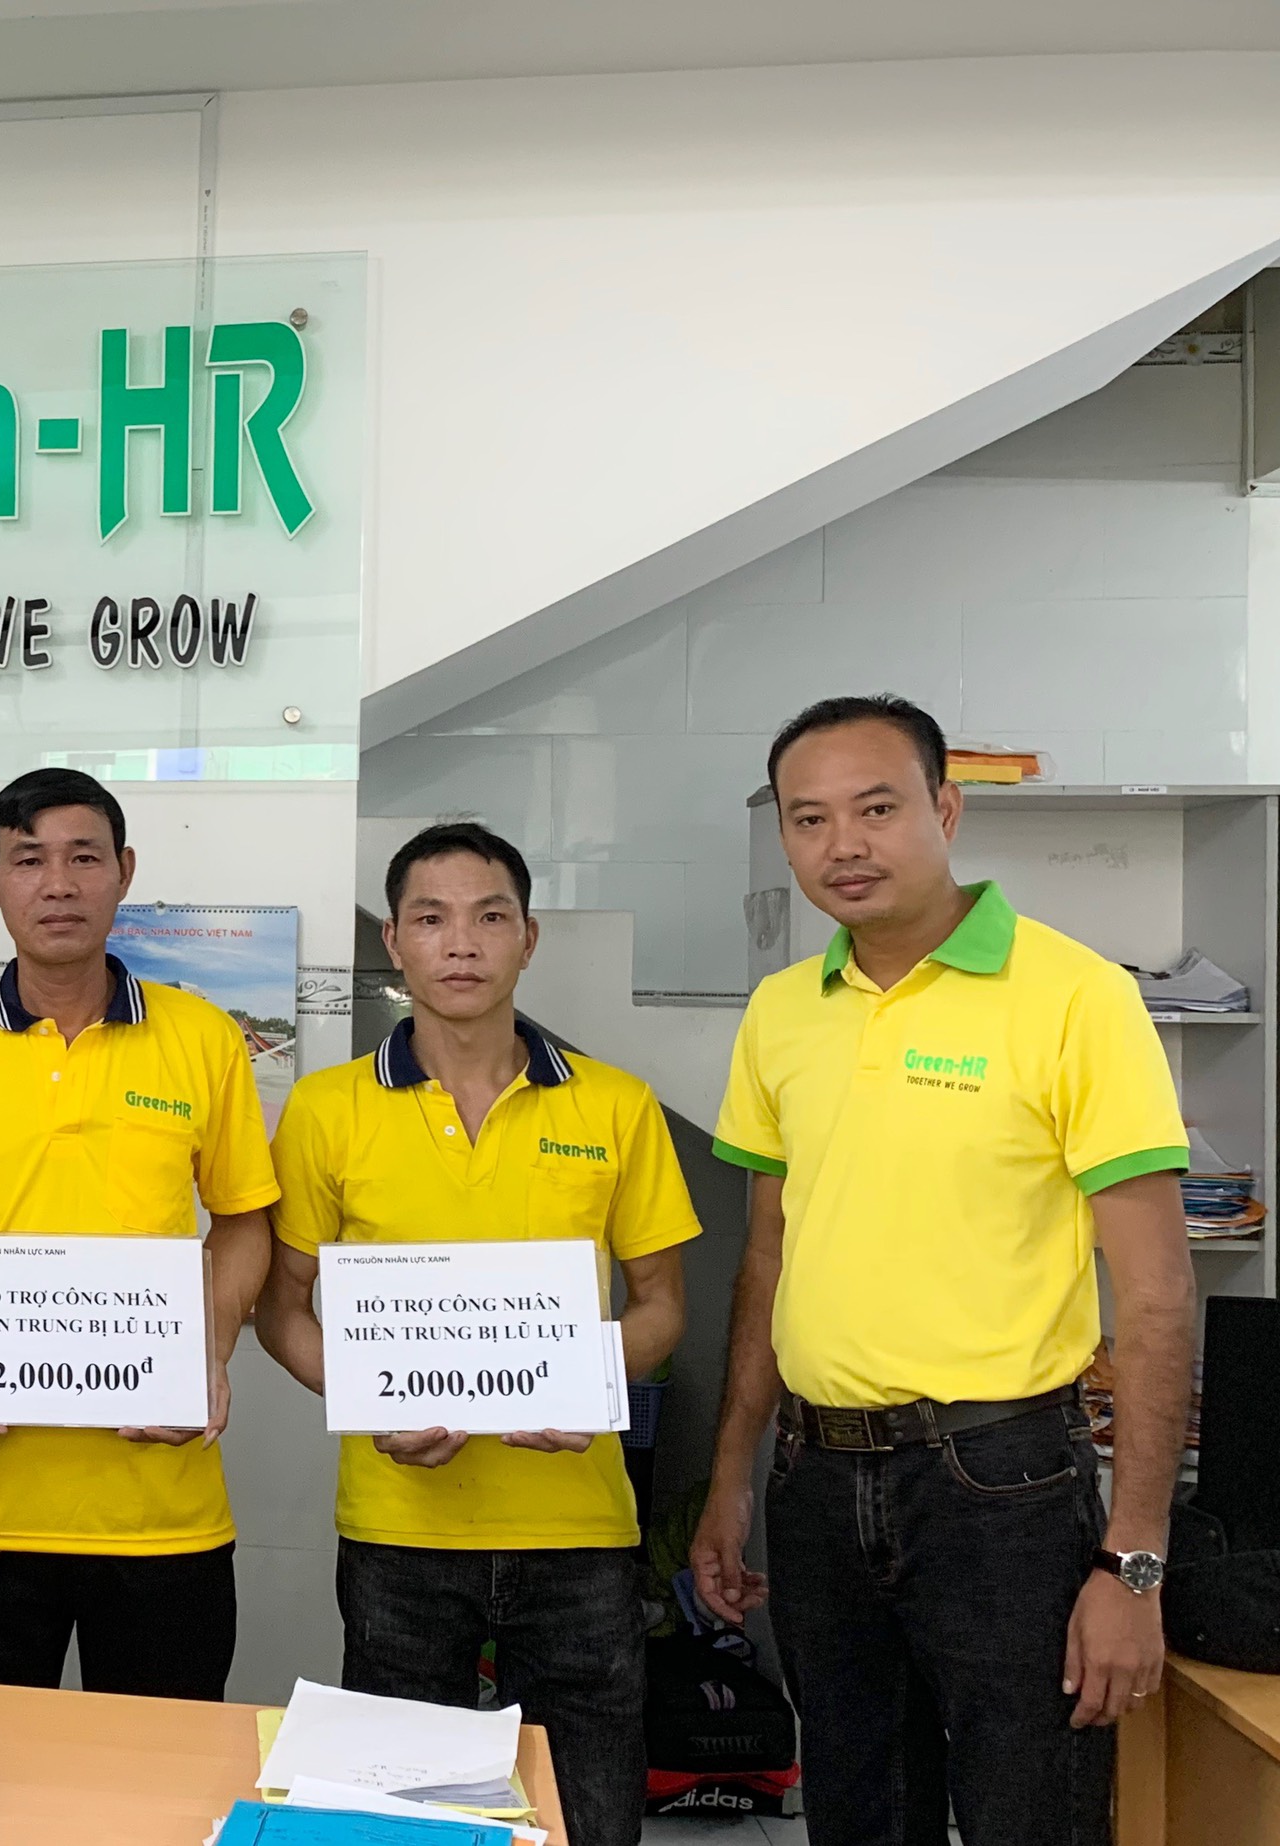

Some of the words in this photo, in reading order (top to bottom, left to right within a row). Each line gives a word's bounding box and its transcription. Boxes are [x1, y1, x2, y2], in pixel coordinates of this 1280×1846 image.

[89, 592, 258, 669] GROW
[231, 929, 253, 937] NAM
[905, 1049, 988, 1080] Green-HR
[907, 1075, 941, 1087] TOGETHER
[945, 1081, 955, 1090] WE
[959, 1083, 981, 1093] GROW
[125, 1091, 192, 1120] Green-HR
[539, 1137, 608, 1162] Green-HR
[3, 1247, 26, 1255] NHÂN
[28, 1248, 43, 1256] LỰC
[385, 1255, 408, 1264] NHÂN
[411, 1256, 426, 1264] LỰC
[7, 1290, 47, 1308] TRỢ
[52, 1287, 107, 1305] CÔNG
[113, 1289, 167, 1306] NHÂN
[391, 1297, 433, 1316] TRỢ
[438, 1294, 496, 1312] CÔNG
[503, 1292, 560, 1311] NHÂN
[16, 1318, 83, 1333] TRUNG
[89, 1319, 107, 1336] BỊ
[113, 1317, 138, 1334] LŨ
[145, 1320, 183, 1338] LỤT
[401, 1325, 471, 1341] TRUNG
[478, 1326, 497, 1343] BỊ
[505, 1322, 530, 1339] LŨ
[538, 1324, 578, 1342] LỤT
